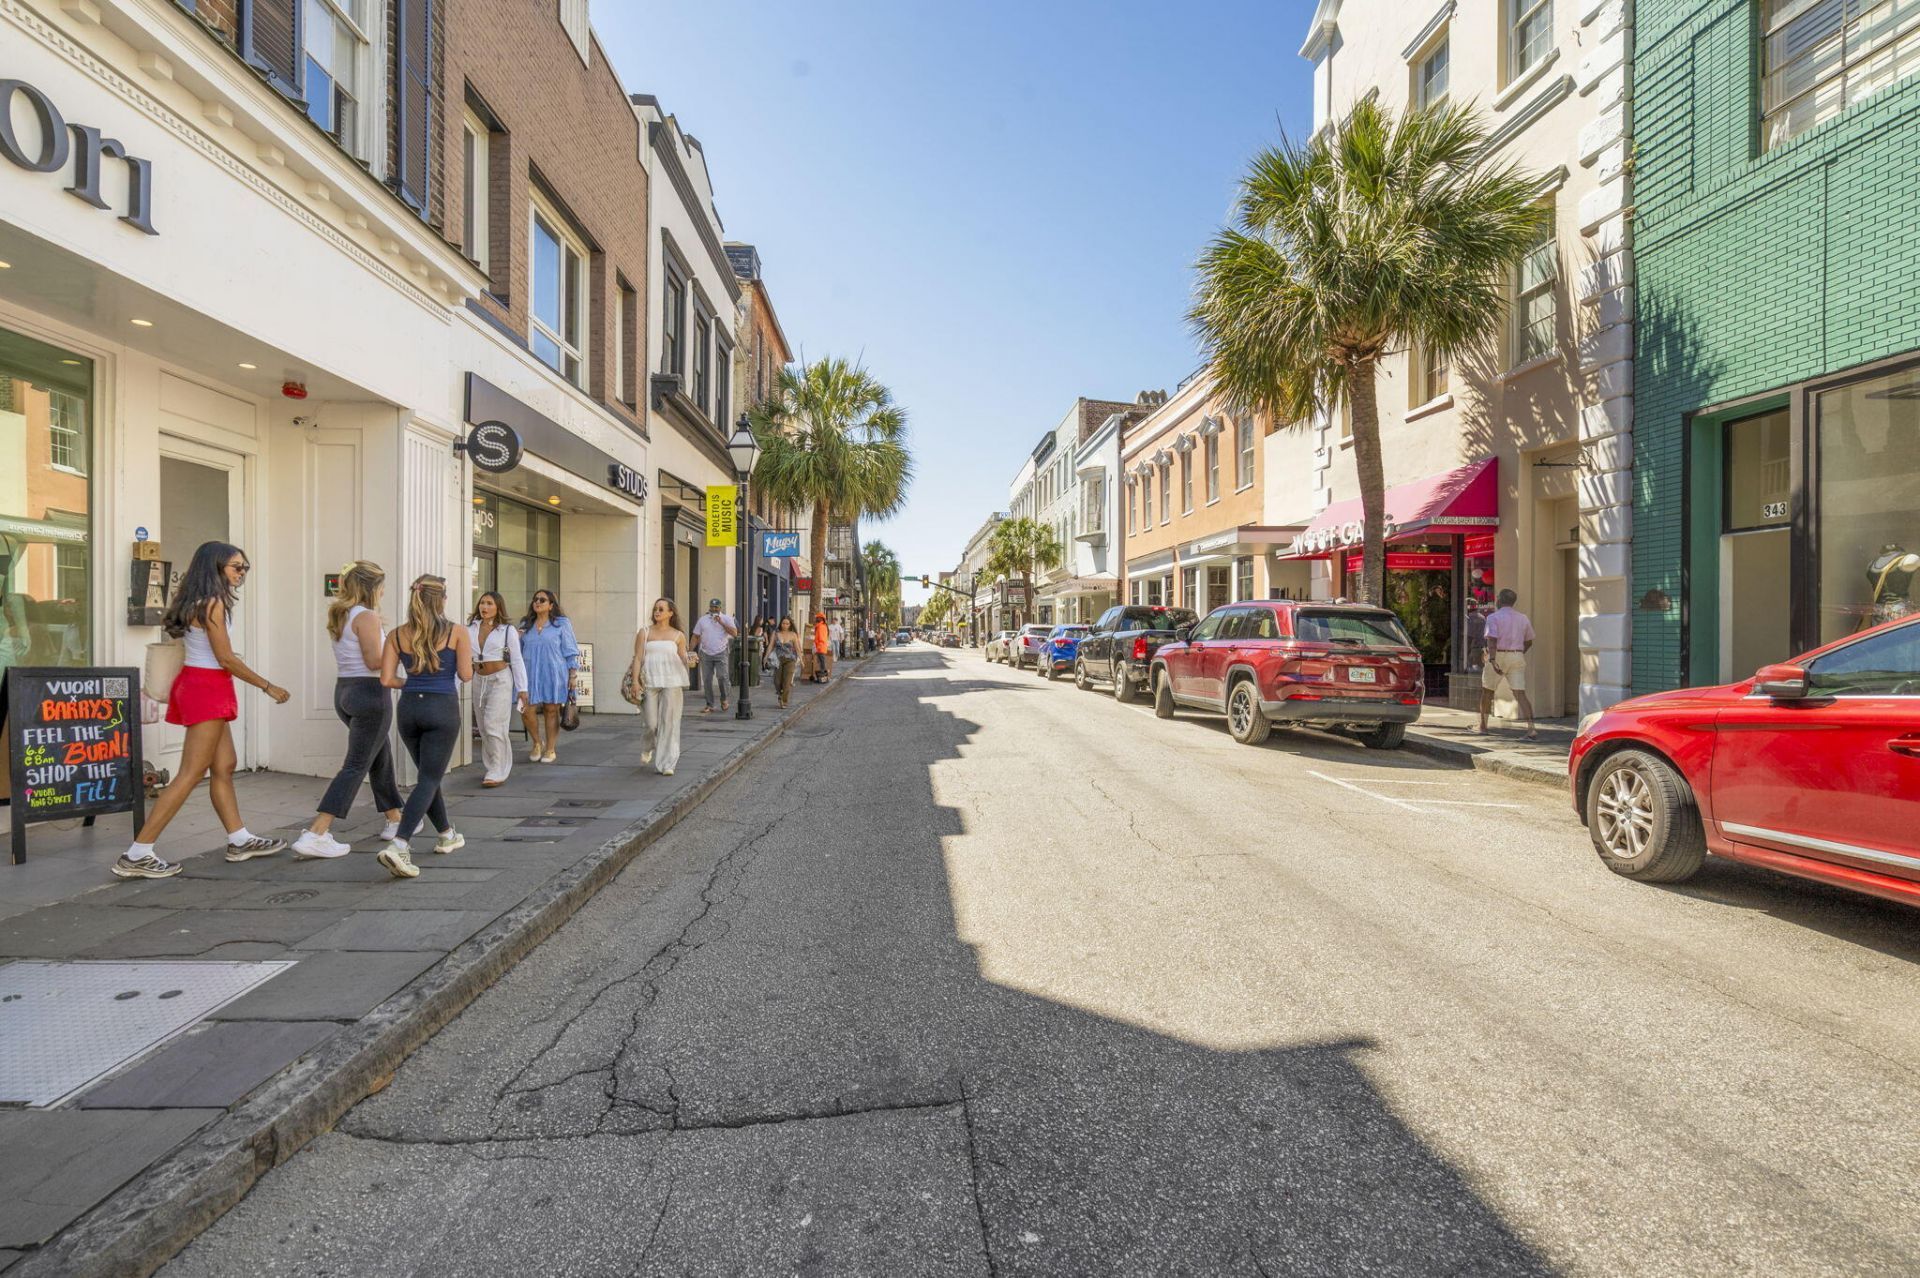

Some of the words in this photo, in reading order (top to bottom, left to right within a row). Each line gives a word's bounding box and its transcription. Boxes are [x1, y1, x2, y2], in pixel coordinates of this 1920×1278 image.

[476, 425, 509, 466] S
[618, 464, 648, 500] STUDS
[711, 494, 720, 502] IS
[711, 503, 720, 538] SPOLETO
[721, 499, 732, 533] MUSIC
[1764, 502, 1786, 518] 343
[765, 535, 798, 554] Mugsy
[46, 680, 100, 695] VUORI
[42, 698, 113, 721] BARRYS
[23, 728, 65, 745] FEEL
[70, 725, 105, 740] THE
[26, 764, 77, 785] SHOP
[83, 763, 117, 779] THE
[76, 778, 117, 804] Fit!
